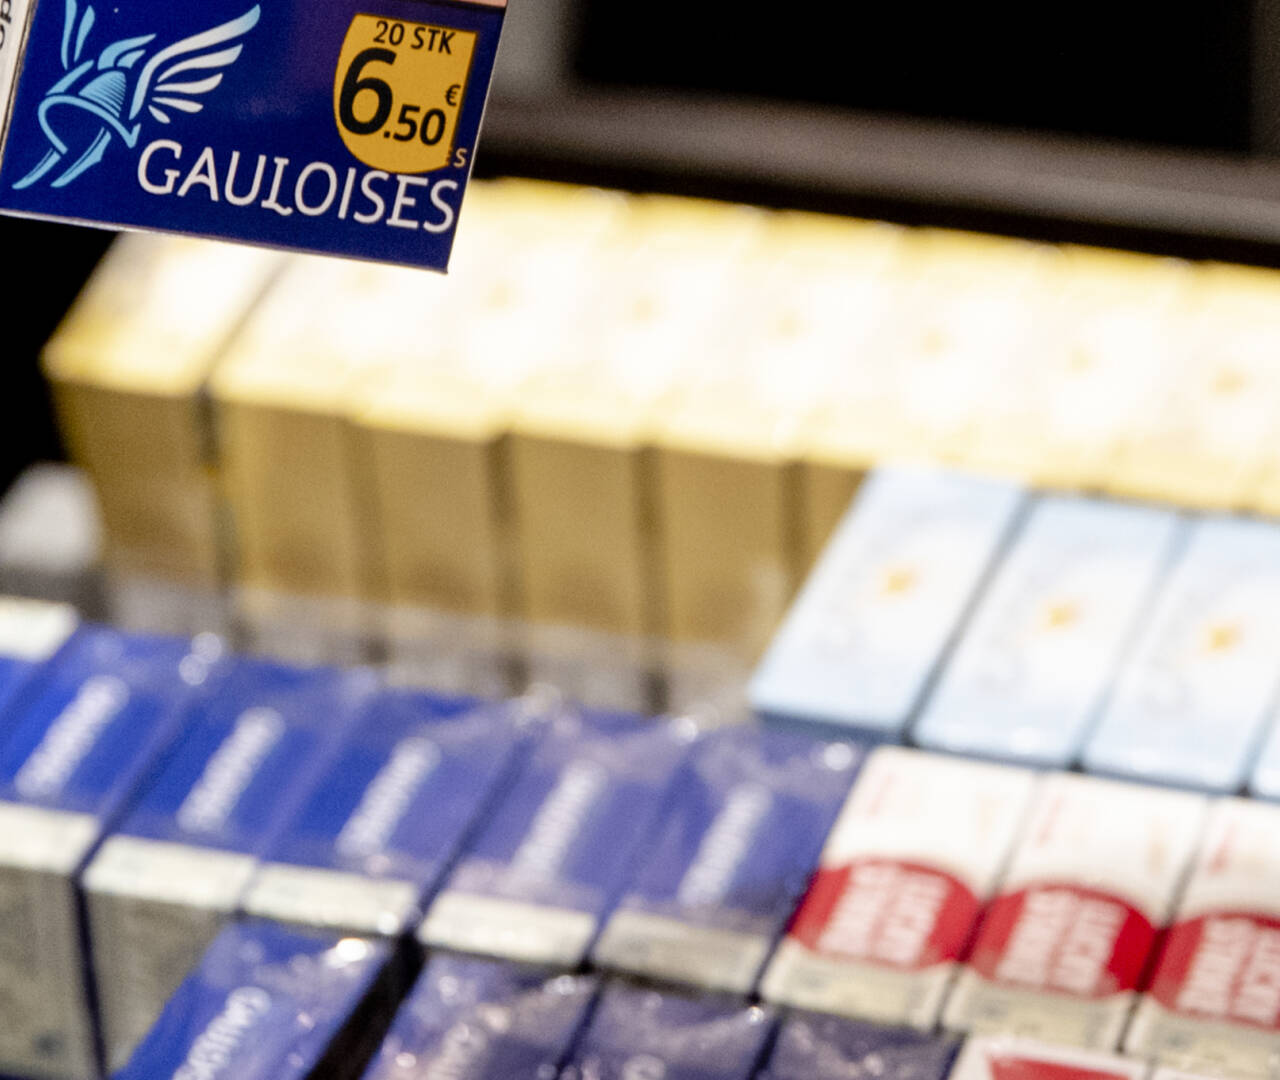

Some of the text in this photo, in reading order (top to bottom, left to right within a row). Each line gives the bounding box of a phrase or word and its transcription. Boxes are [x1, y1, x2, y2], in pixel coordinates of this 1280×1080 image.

[373, 19, 457, 55] 20 STK
[137, 138, 459, 234] GAULOISES
